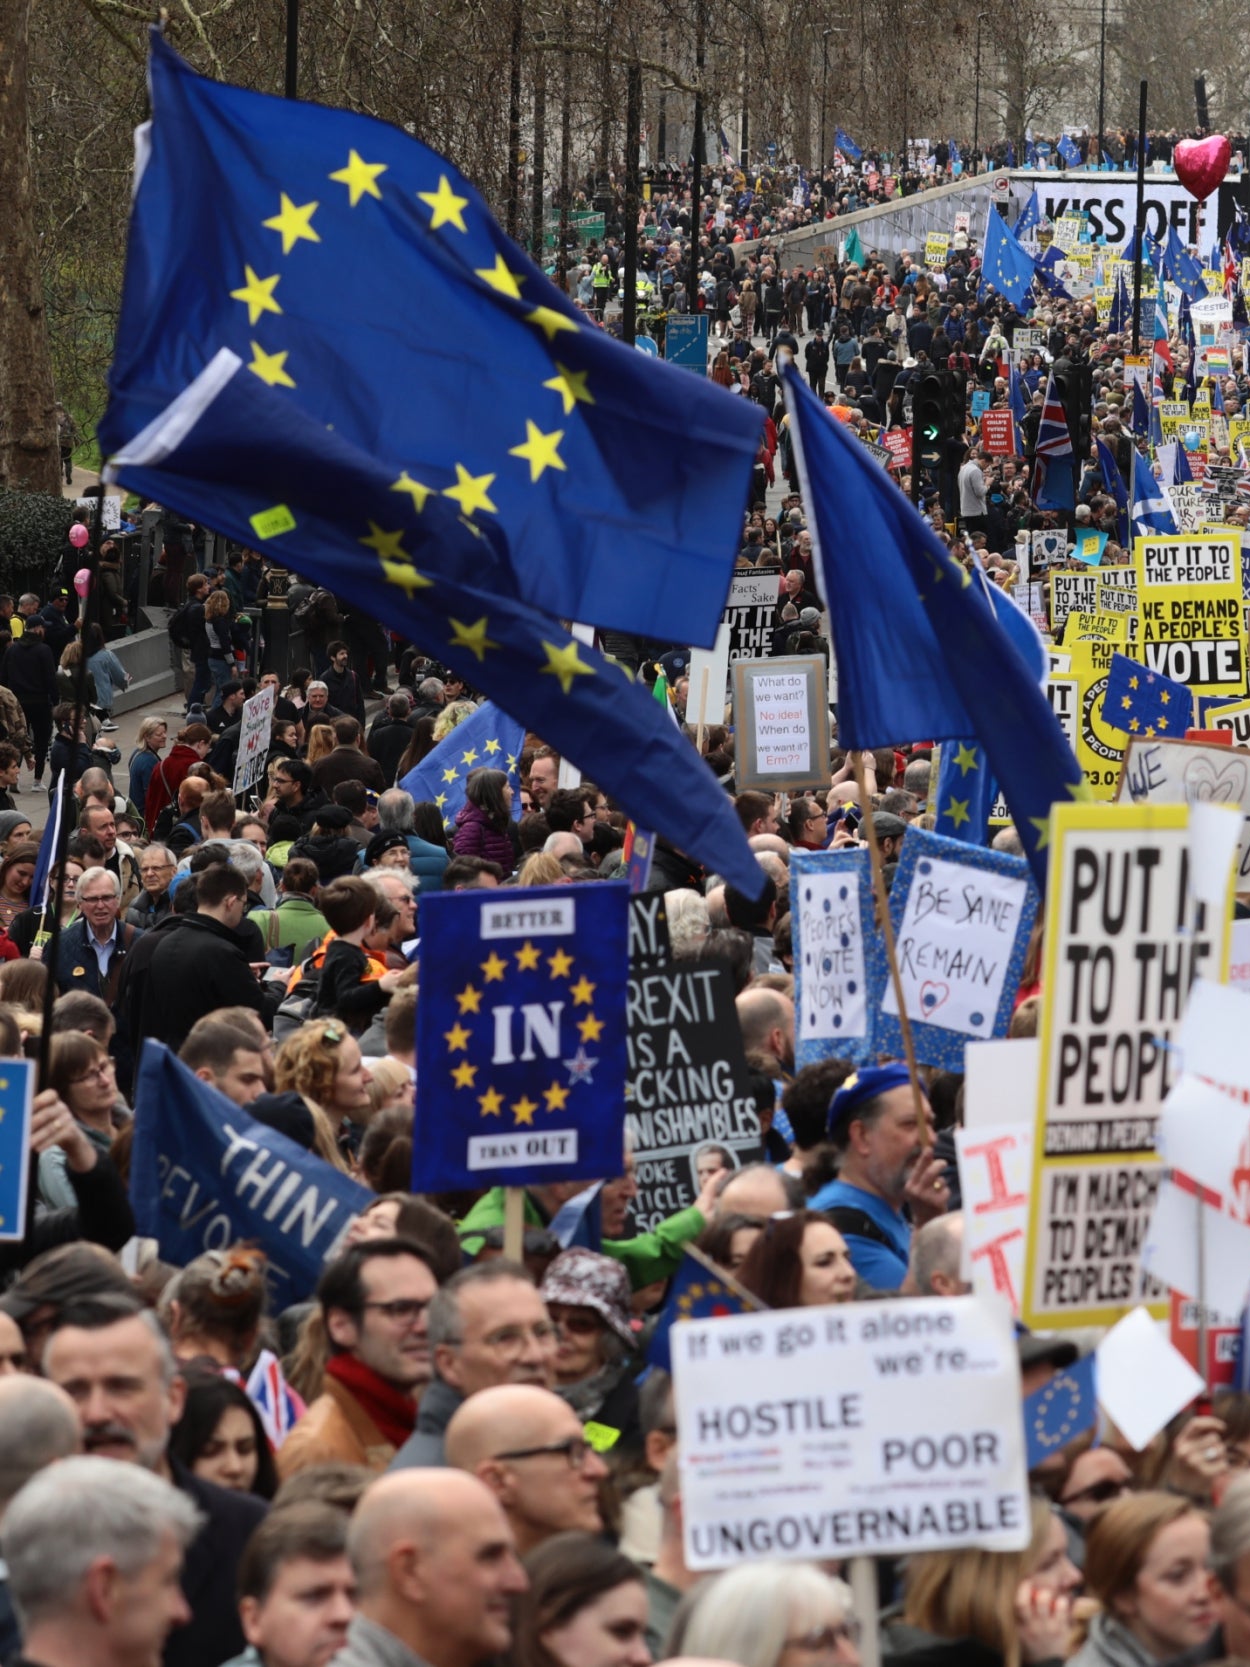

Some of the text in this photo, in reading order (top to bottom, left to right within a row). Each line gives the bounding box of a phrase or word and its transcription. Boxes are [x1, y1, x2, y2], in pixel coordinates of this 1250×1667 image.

[1168, 486, 1195, 497] OUR
[1145, 545, 1230, 566] PUT IT TO
[1054, 577, 1096, 592] PUT IT
[1146, 565, 1231, 583] THE PEOPLE
[731, 583, 761, 595] Facts'
[751, 593, 775, 603] Sake
[1055, 591, 1096, 605] TO THE
[1079, 613, 1118, 628] PUT IT TO
[1143, 599, 1239, 620] WE DEMAND
[1078, 622, 1116, 635] THE PEOPLE
[1144, 620, 1239, 640] A PEOPLE'S
[1145, 640, 1241, 683] VOTE
[757, 676, 801, 687] What do
[755, 690, 804, 702] we want?
[760, 711, 775, 720] No
[758, 724, 806, 735] When do
[766, 754, 800, 766] Erm??
[773, 744, 795, 752] want
[796, 743, 808, 752] it?
[233, 748, 268, 793] FUTURE
[1125, 745, 1167, 804] WE
[1067, 846, 1163, 936] PUT
[490, 907, 564, 931] BETTER
[912, 881, 1014, 933] BE SANE
[813, 947, 855, 981] VOTE
[900, 937, 998, 987] REMAIN
[1066, 940, 1212, 1025] TO THE
[625, 970, 721, 1029] REXIT
[808, 983, 844, 1010] NOW
[491, 1001, 565, 1067] IN
[625, 1028, 691, 1069] IS A
[526, 1135, 569, 1165] OUT
[1043, 1263, 1135, 1305] PEOPLES
[686, 1310, 956, 1360] If we go it alone
[697, 1394, 864, 1443] HOSTILE
[881, 1431, 1001, 1473] POOR
[689, 1493, 1022, 1559] UNGOVERNABLE
